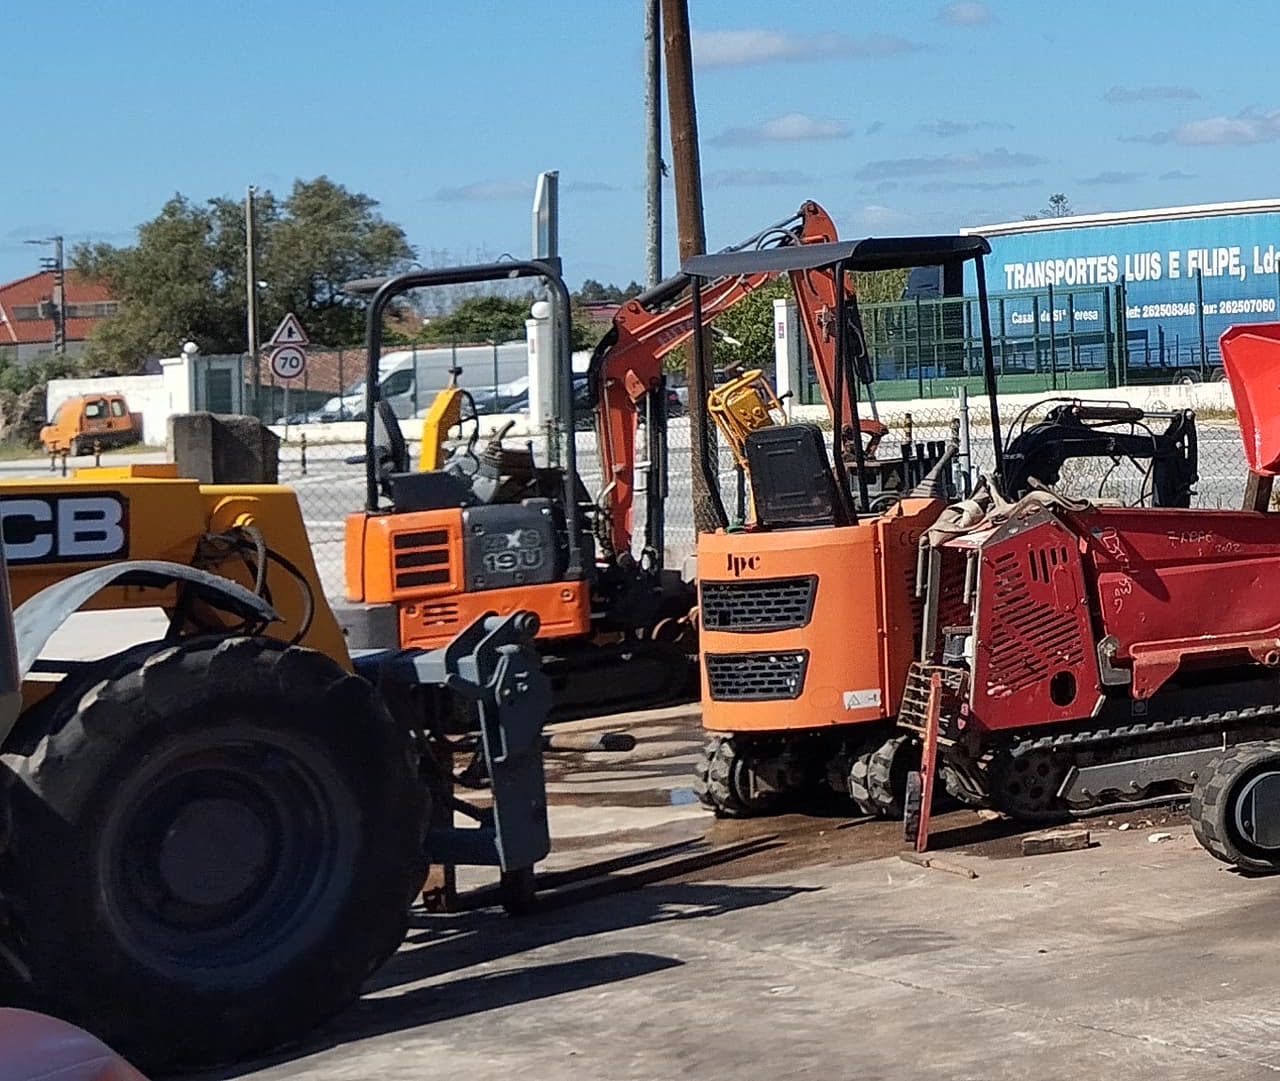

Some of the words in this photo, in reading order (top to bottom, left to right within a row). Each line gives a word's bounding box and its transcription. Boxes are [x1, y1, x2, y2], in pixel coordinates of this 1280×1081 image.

[1004, 254, 1119, 290] TRANSPORTES
[1125, 251, 1162, 281] LUIS
[1169, 250, 1180, 278] E
[1187, 246, 1247, 281] FILIPE,
[1072, 307, 1099, 321] eresa
[1202, 301, 1218, 315] ax:
[279, 356, 300, 369] 70
[483, 549, 543, 572] 19U
